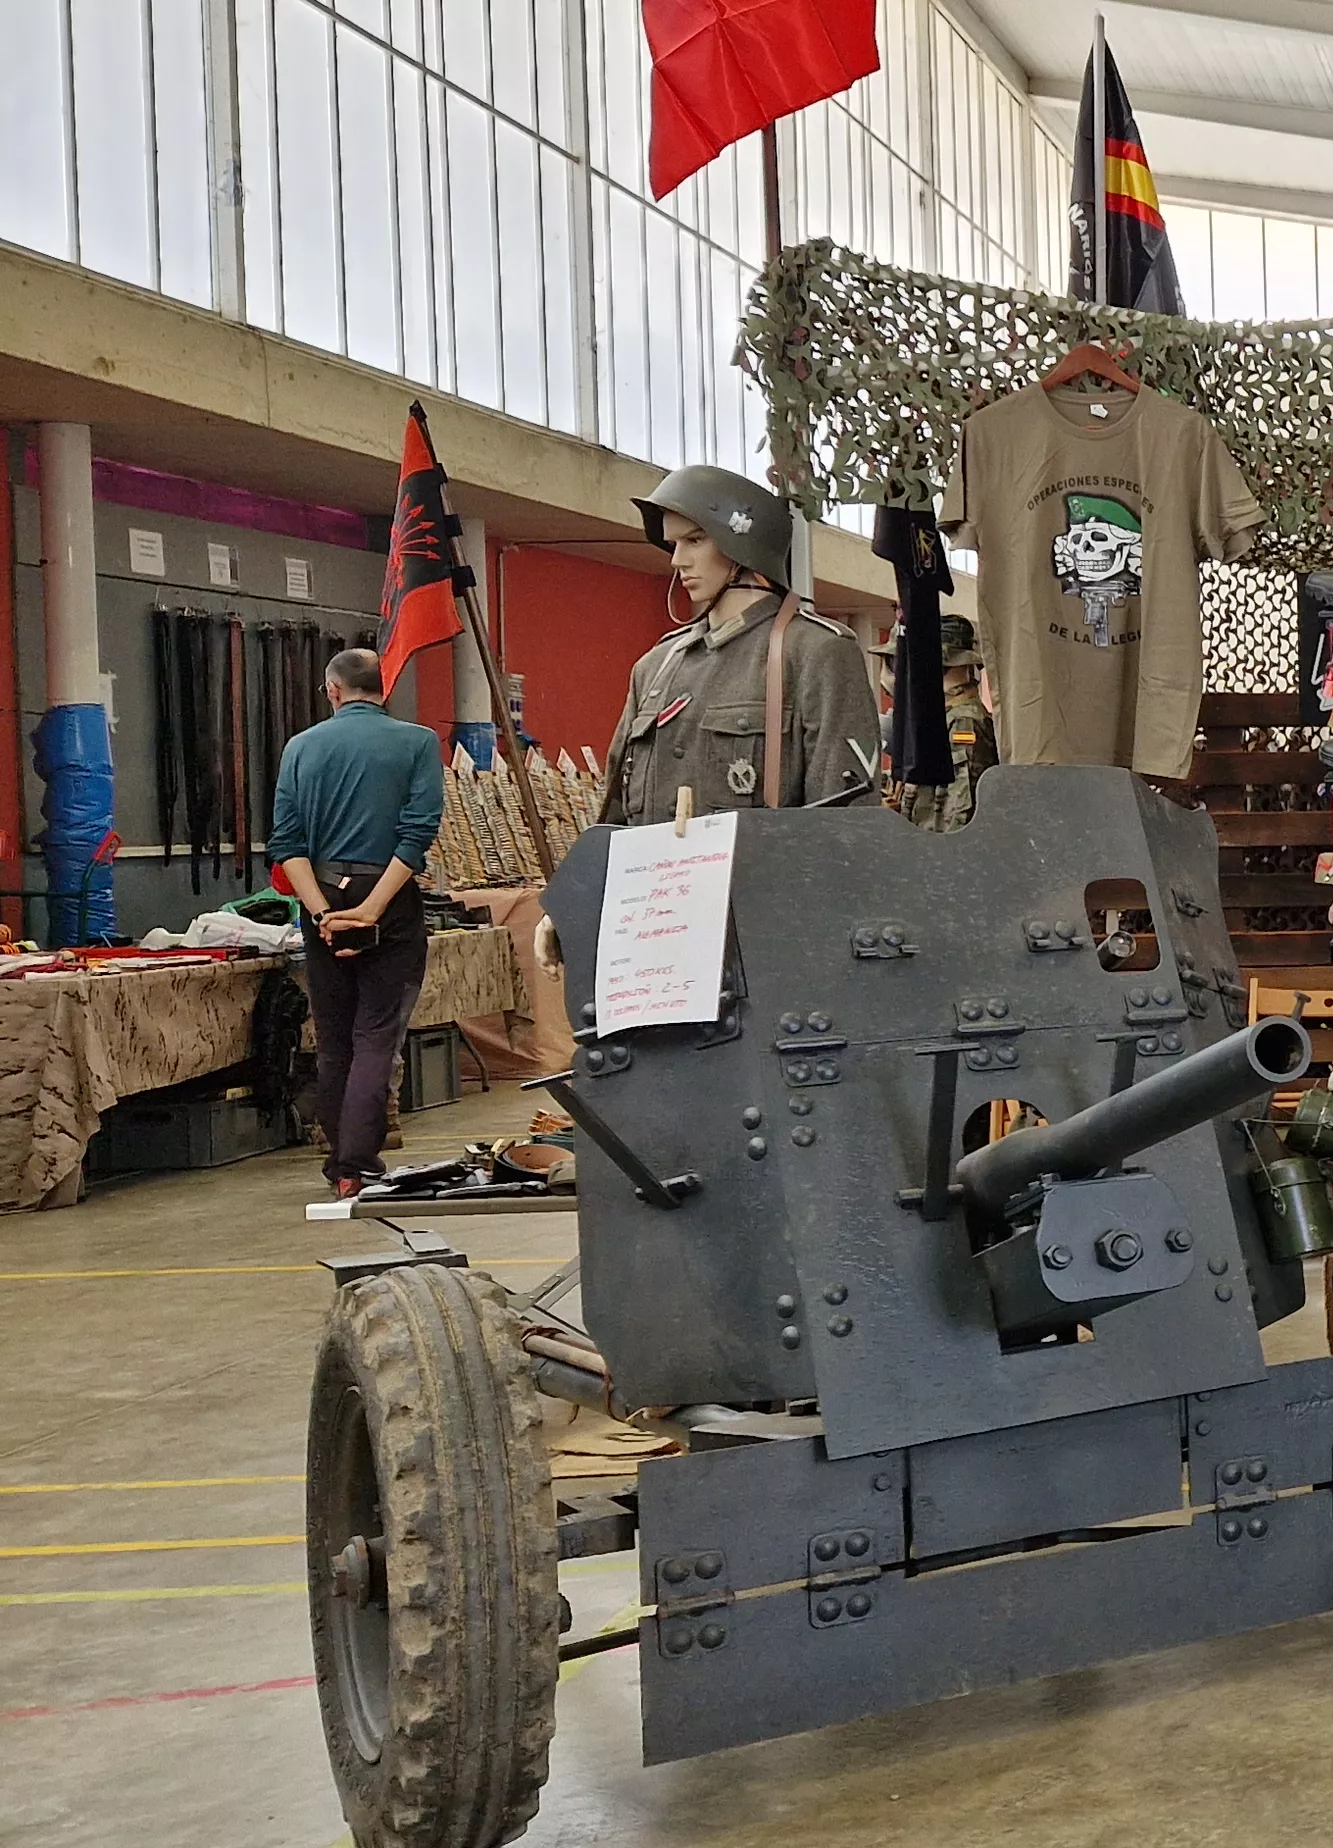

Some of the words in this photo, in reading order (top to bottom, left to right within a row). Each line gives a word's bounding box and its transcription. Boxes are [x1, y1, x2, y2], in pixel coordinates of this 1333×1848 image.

[1027, 475, 1100, 511] OPERACIONES
[1049, 622, 1069, 639] DE
[1073, 631, 1091, 645] LA
